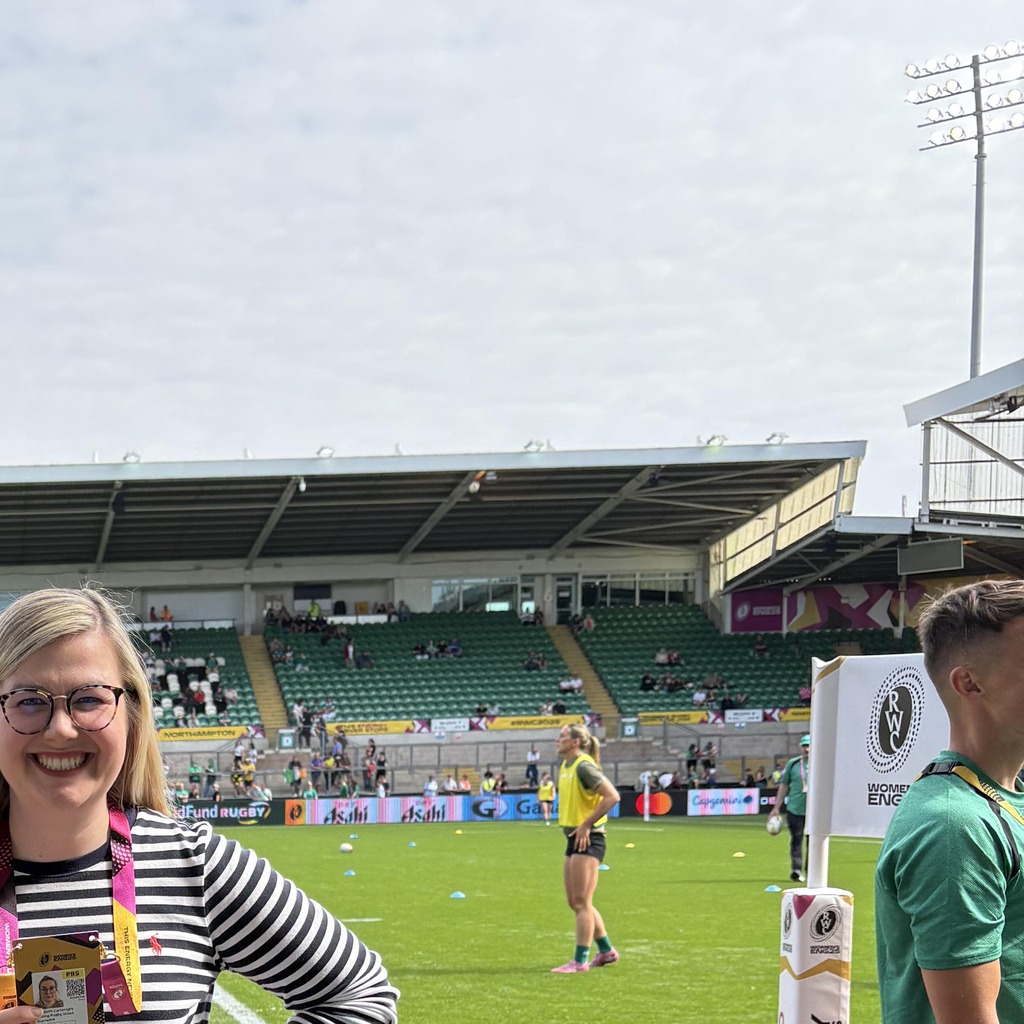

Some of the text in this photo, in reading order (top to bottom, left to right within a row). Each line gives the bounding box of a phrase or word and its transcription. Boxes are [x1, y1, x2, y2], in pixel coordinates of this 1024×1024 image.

[884, 690, 904, 753] RWC
[220, 807, 267, 818] RUGBY
[324, 806, 368, 824] Asahi
[401, 804, 446, 823] Asahi
[124, 945, 132, 977] ENERGY
